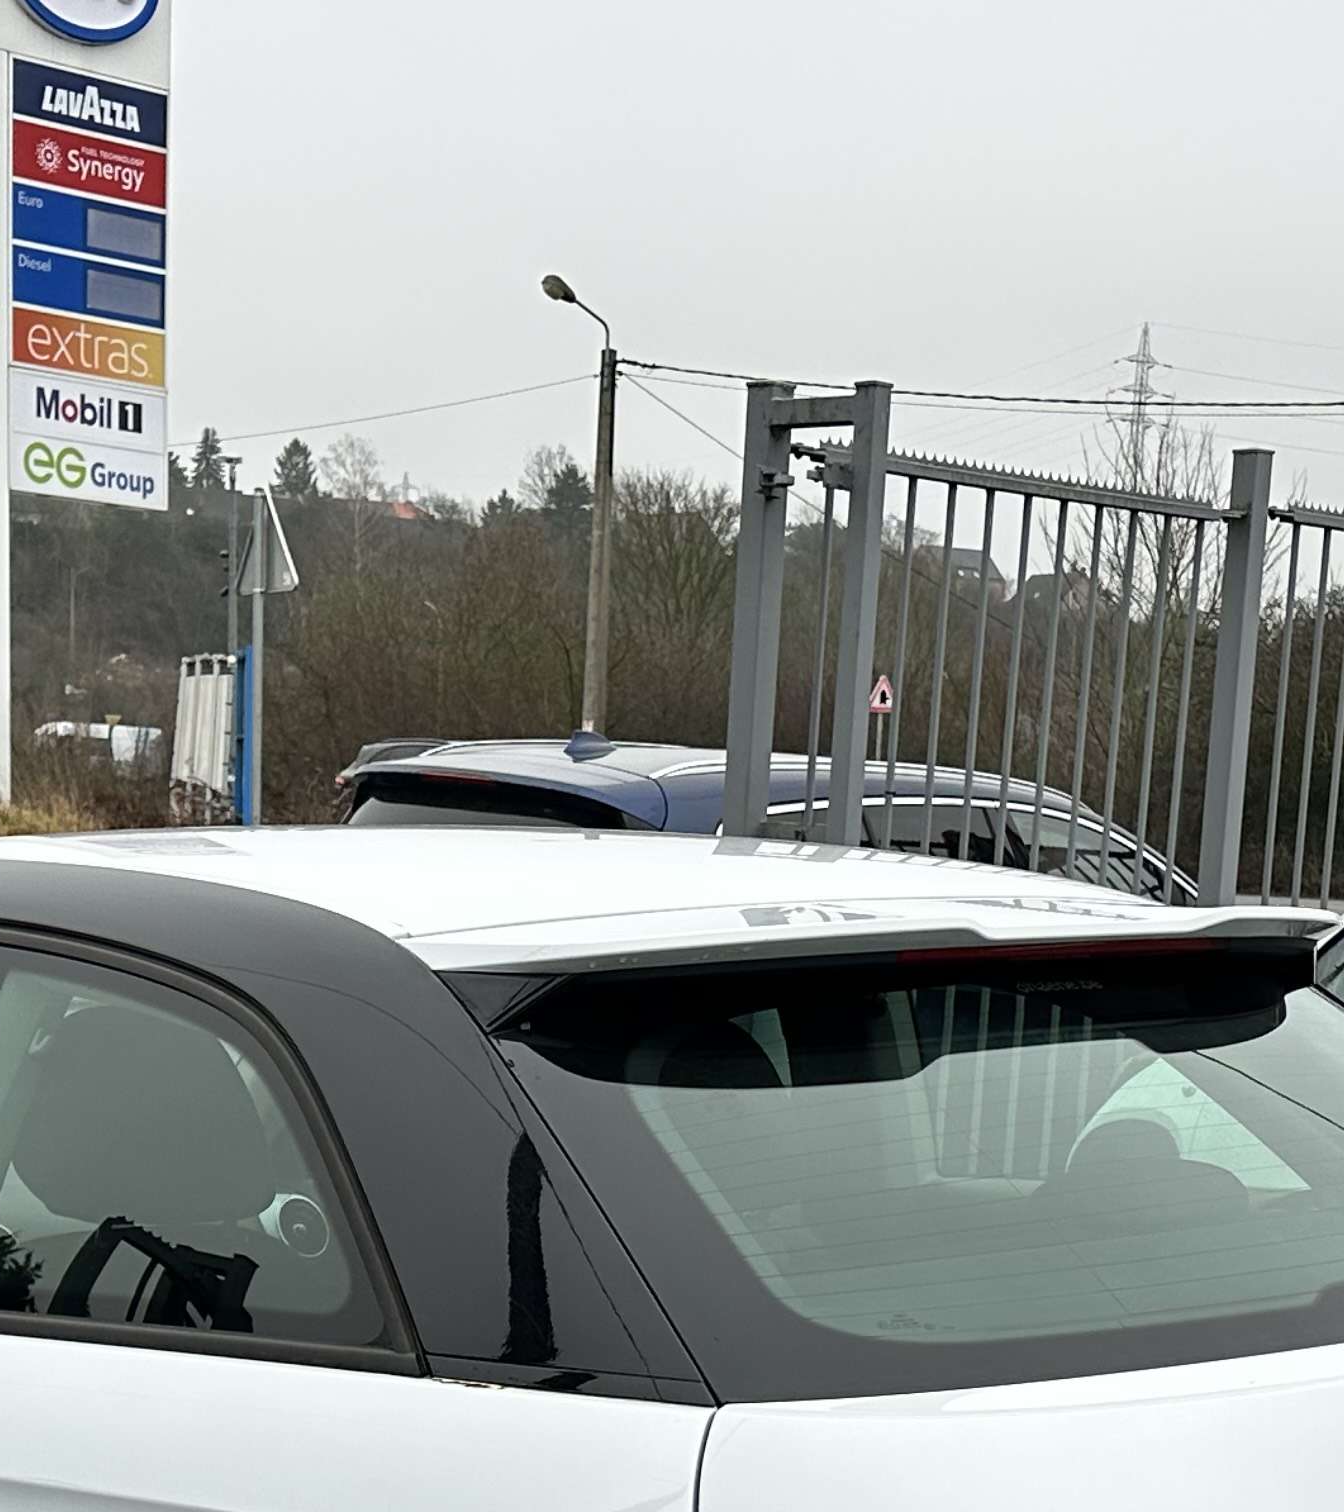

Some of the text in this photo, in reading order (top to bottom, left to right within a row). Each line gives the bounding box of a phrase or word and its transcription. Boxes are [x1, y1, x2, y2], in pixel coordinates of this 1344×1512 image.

[67, 149, 145, 192] Synergy
[17, 190, 44, 209] Euro
[17, 253, 52, 272] Diesel
[27, 323, 149, 377] extras
[35, 386, 112, 429] Mobil
[90, 462, 155, 499] Group
